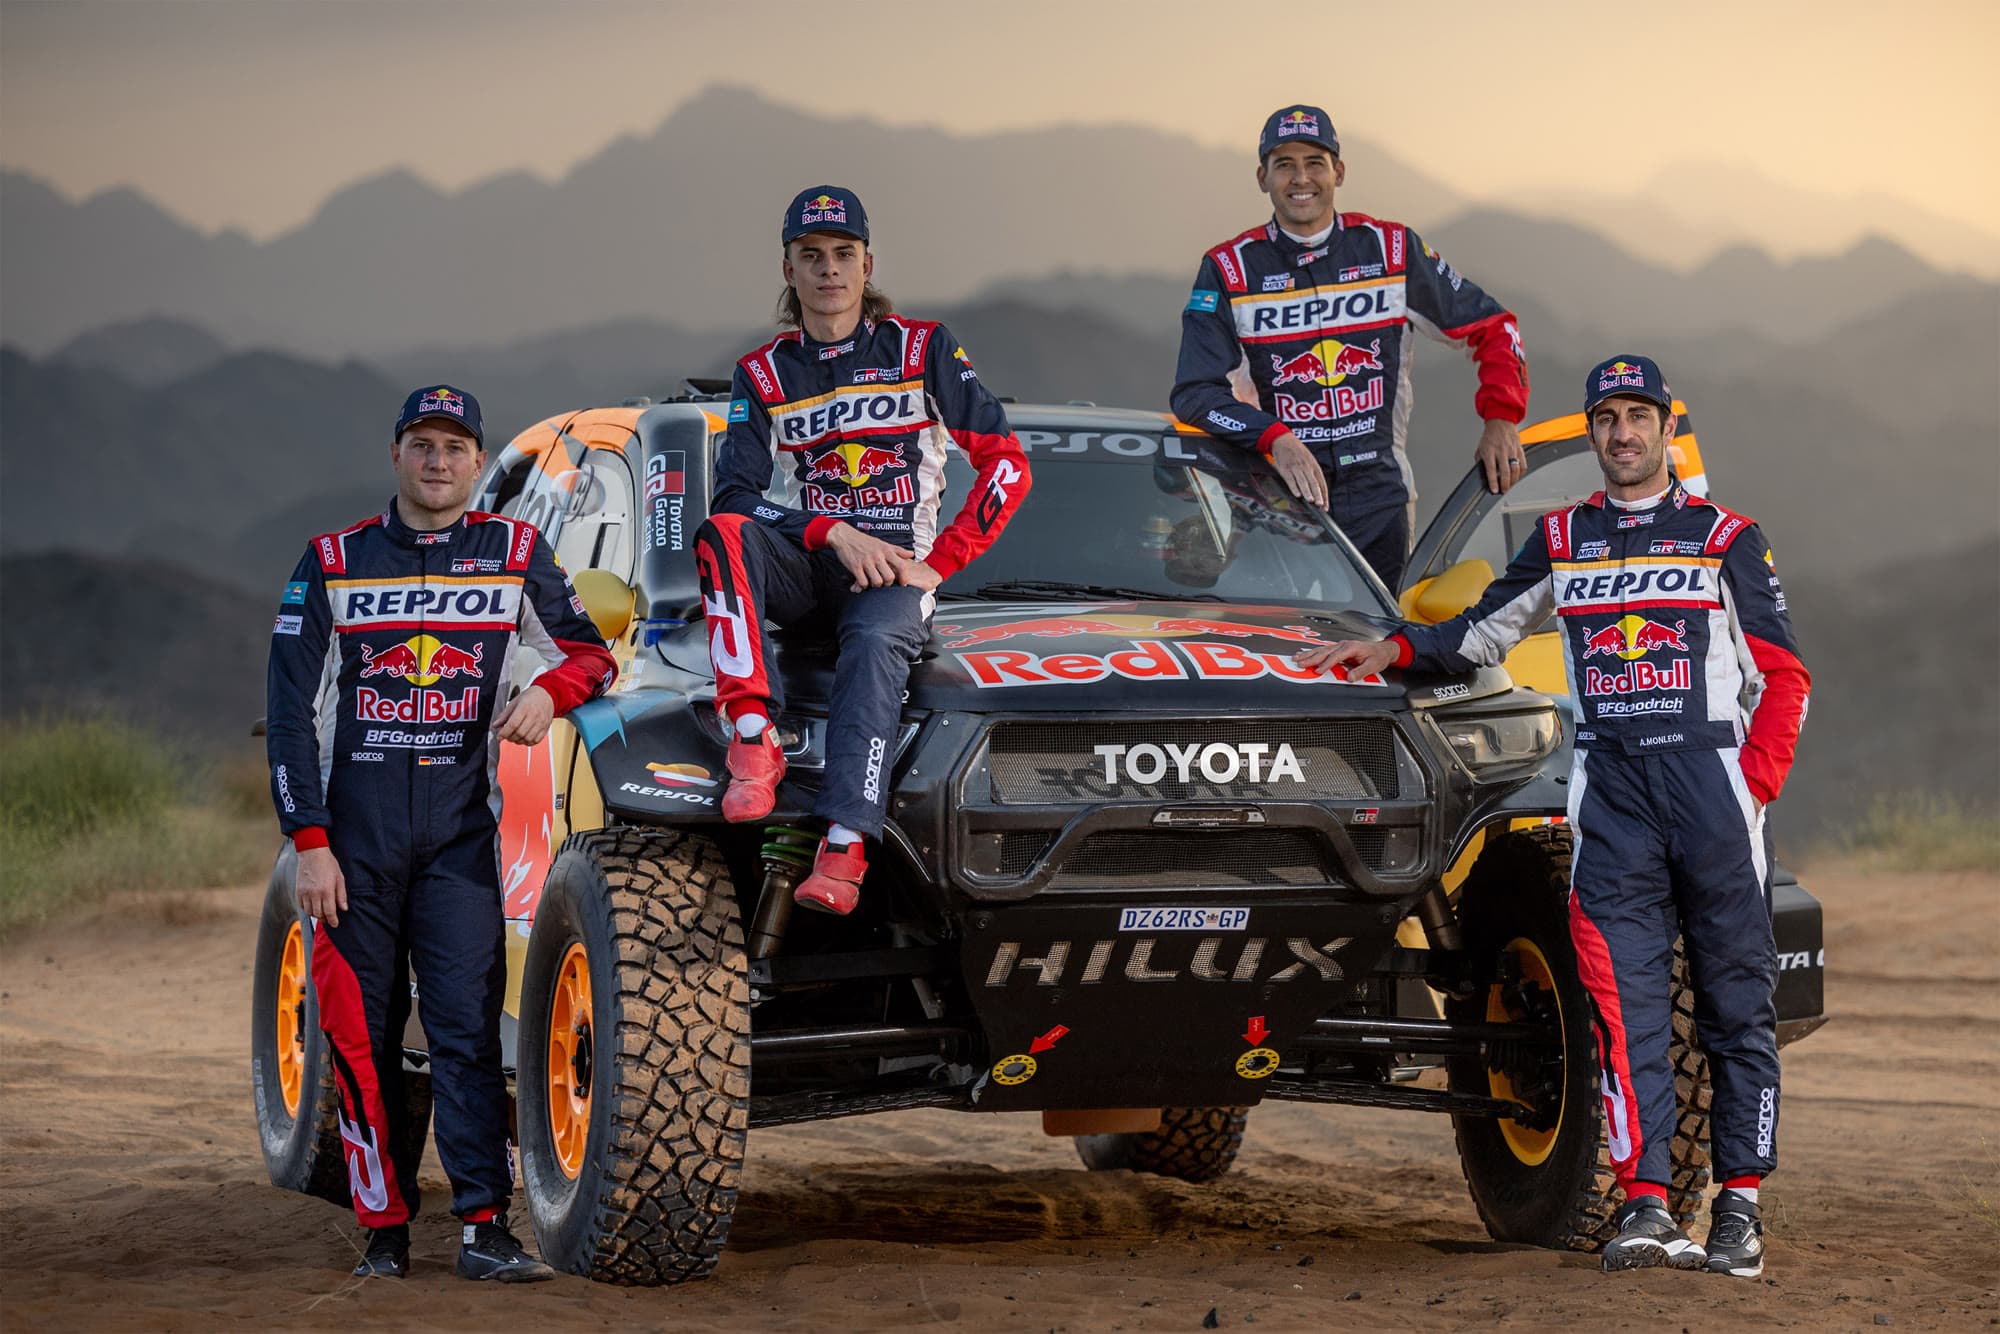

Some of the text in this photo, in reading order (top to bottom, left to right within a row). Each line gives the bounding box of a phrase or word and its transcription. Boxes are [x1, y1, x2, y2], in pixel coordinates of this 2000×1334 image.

[802, 210, 846, 225] Red Bull
[1253, 290, 1389, 332] REPSOL
[909, 328, 927, 367] sparco
[748, 359, 774, 395] sparco
[1599, 375, 1644, 391] Red Bull
[419, 400, 464, 416] Red Bull
[1274, 376, 1383, 422] Red Bull
[783, 395, 914, 440] REPSOL
[1207, 410, 1247, 431] sparco
[1014, 430, 1198, 460] PSOL
[646, 454, 666, 500] GR
[805, 473, 915, 512] Red Bull
[976, 458, 1022, 536] GR
[655, 497, 668, 547] GAZOO
[670, 496, 684, 551] TOYOTA
[1548, 515, 1563, 551] sparco
[1714, 518, 1742, 547] sparco
[320, 536, 336, 566] sparco
[515, 527, 533, 563] sparco
[1564, 568, 1705, 601] REPSOL
[346, 589, 506, 619] REPSOL
[953, 641, 1189, 688] Red
[1585, 658, 1691, 696] Red Bull
[356, 686, 480, 723] Red Bull
[1433, 683, 1470, 701] sparco
[1597, 697, 1684, 714] BFGoodrich
[365, 729, 465, 745] BFGoodrich
[1640, 732, 1684, 747] A.MONLEÓN
[351, 751, 385, 762] sparco
[863, 737, 886, 804] sparco
[1094, 742, 1307, 785] TOYOTA
[277, 764, 295, 813] sparco
[620, 782, 714, 806] REPSOL
[1123, 910, 1247, 929] DZ62RS GP
[985, 937, 1354, 986] HILUX
[1757, 1087, 1775, 1158] sparco
